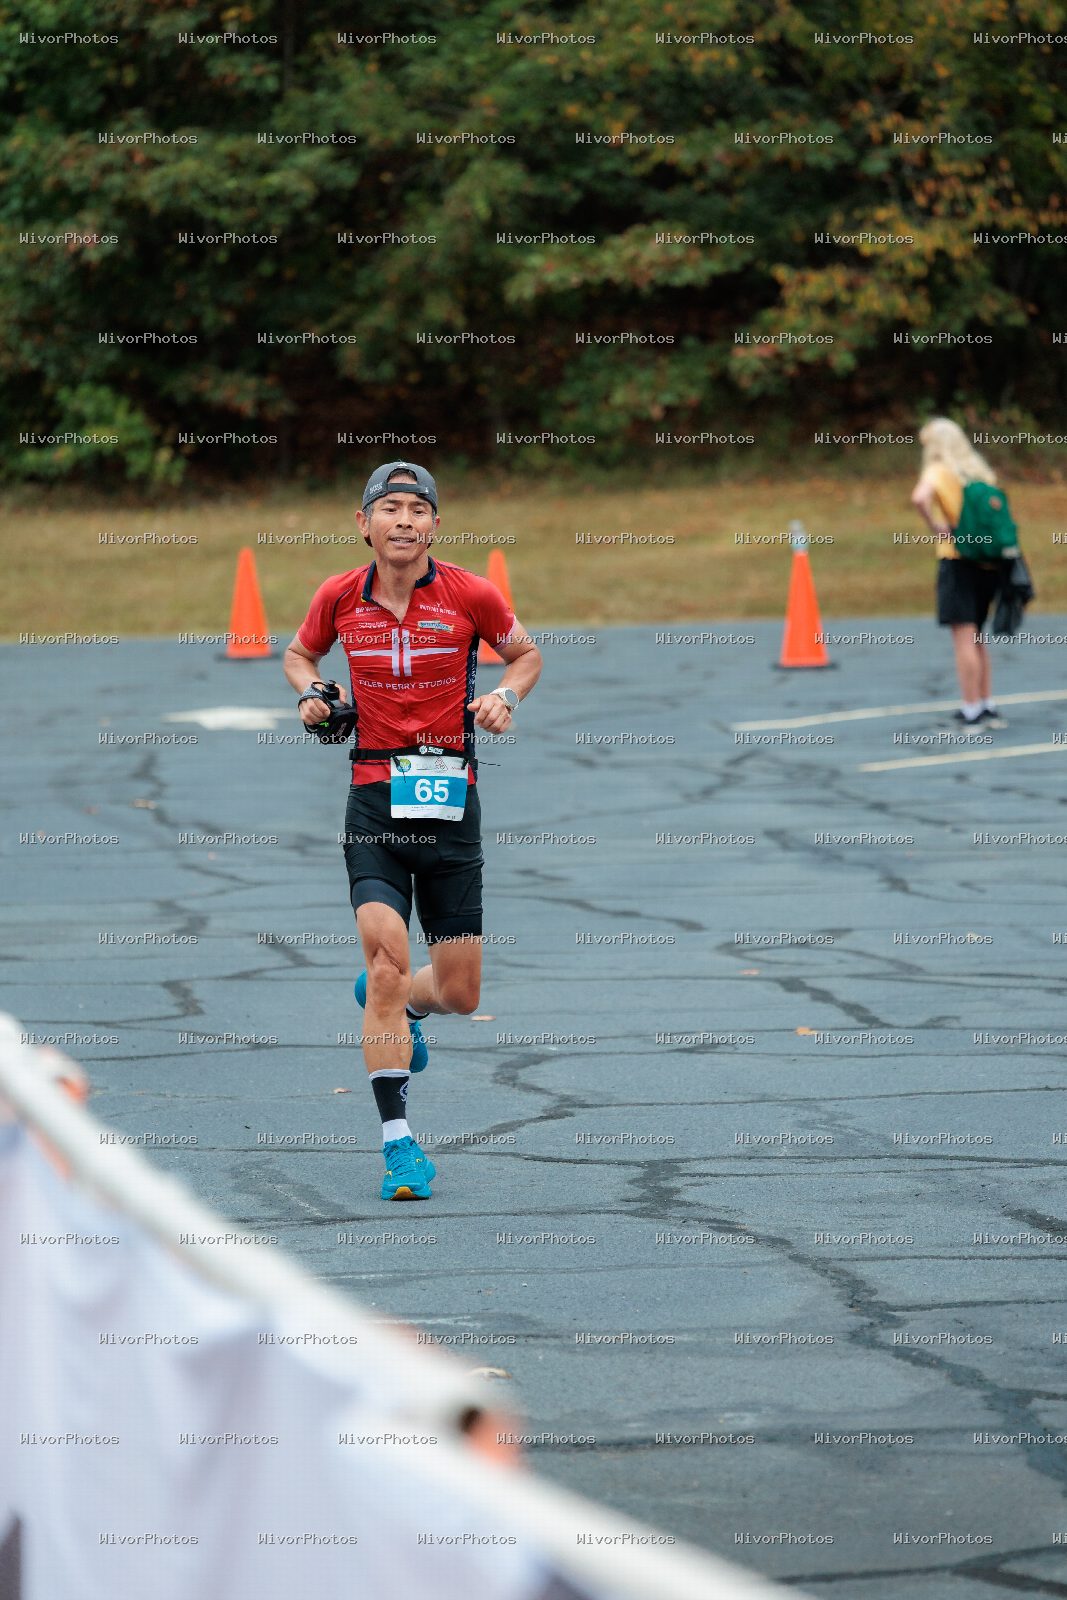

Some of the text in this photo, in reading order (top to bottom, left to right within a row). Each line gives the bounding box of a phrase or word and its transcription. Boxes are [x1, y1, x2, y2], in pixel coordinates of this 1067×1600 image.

[386, 682, 416, 690] PERRY
[418, 676, 457, 689] STUDIOS
[415, 778, 450, 803] 65
